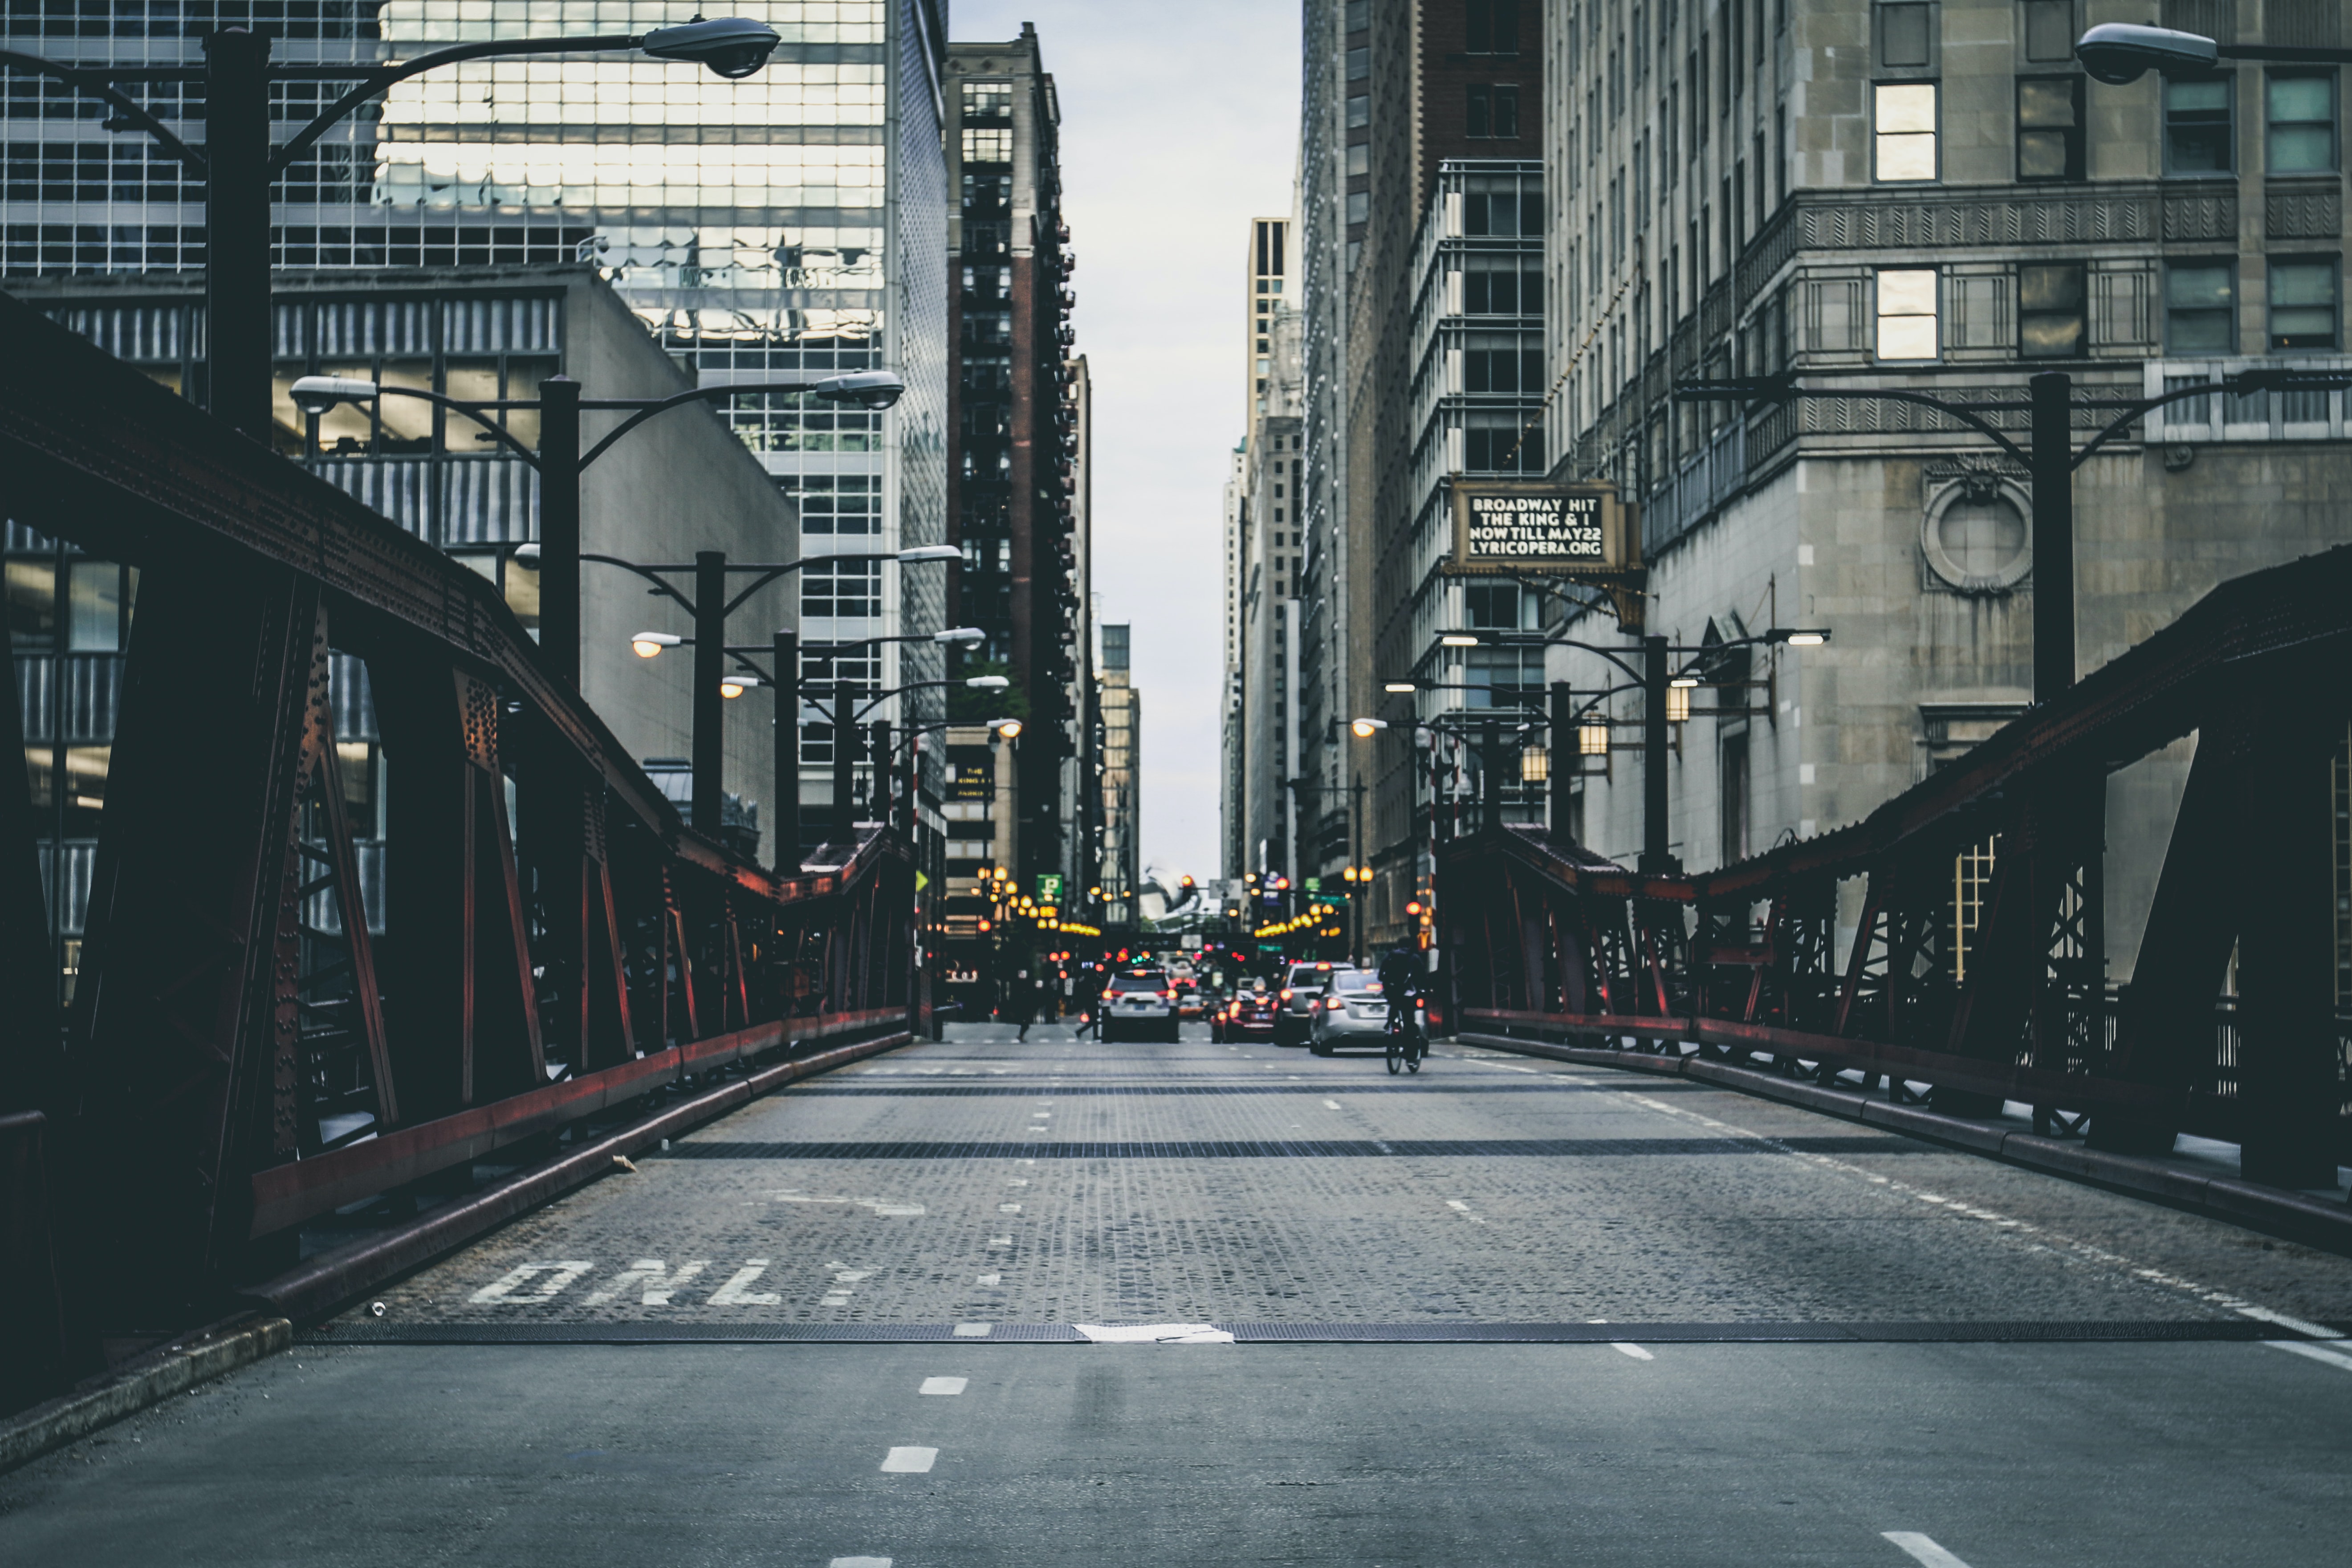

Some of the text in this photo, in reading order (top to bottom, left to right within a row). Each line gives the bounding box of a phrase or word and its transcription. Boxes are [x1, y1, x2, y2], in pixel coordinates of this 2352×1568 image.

[1473, 498, 1597, 512] BROADWAY HIT
[1480, 513, 1589, 526] THE KING & I
[1469, 527, 1508, 540] NOW
[1510, 527, 1546, 540] TILL
[1469, 541, 1601, 554] LYRICOPERA.ORG
[467, 1258, 883, 1307] ONLY
